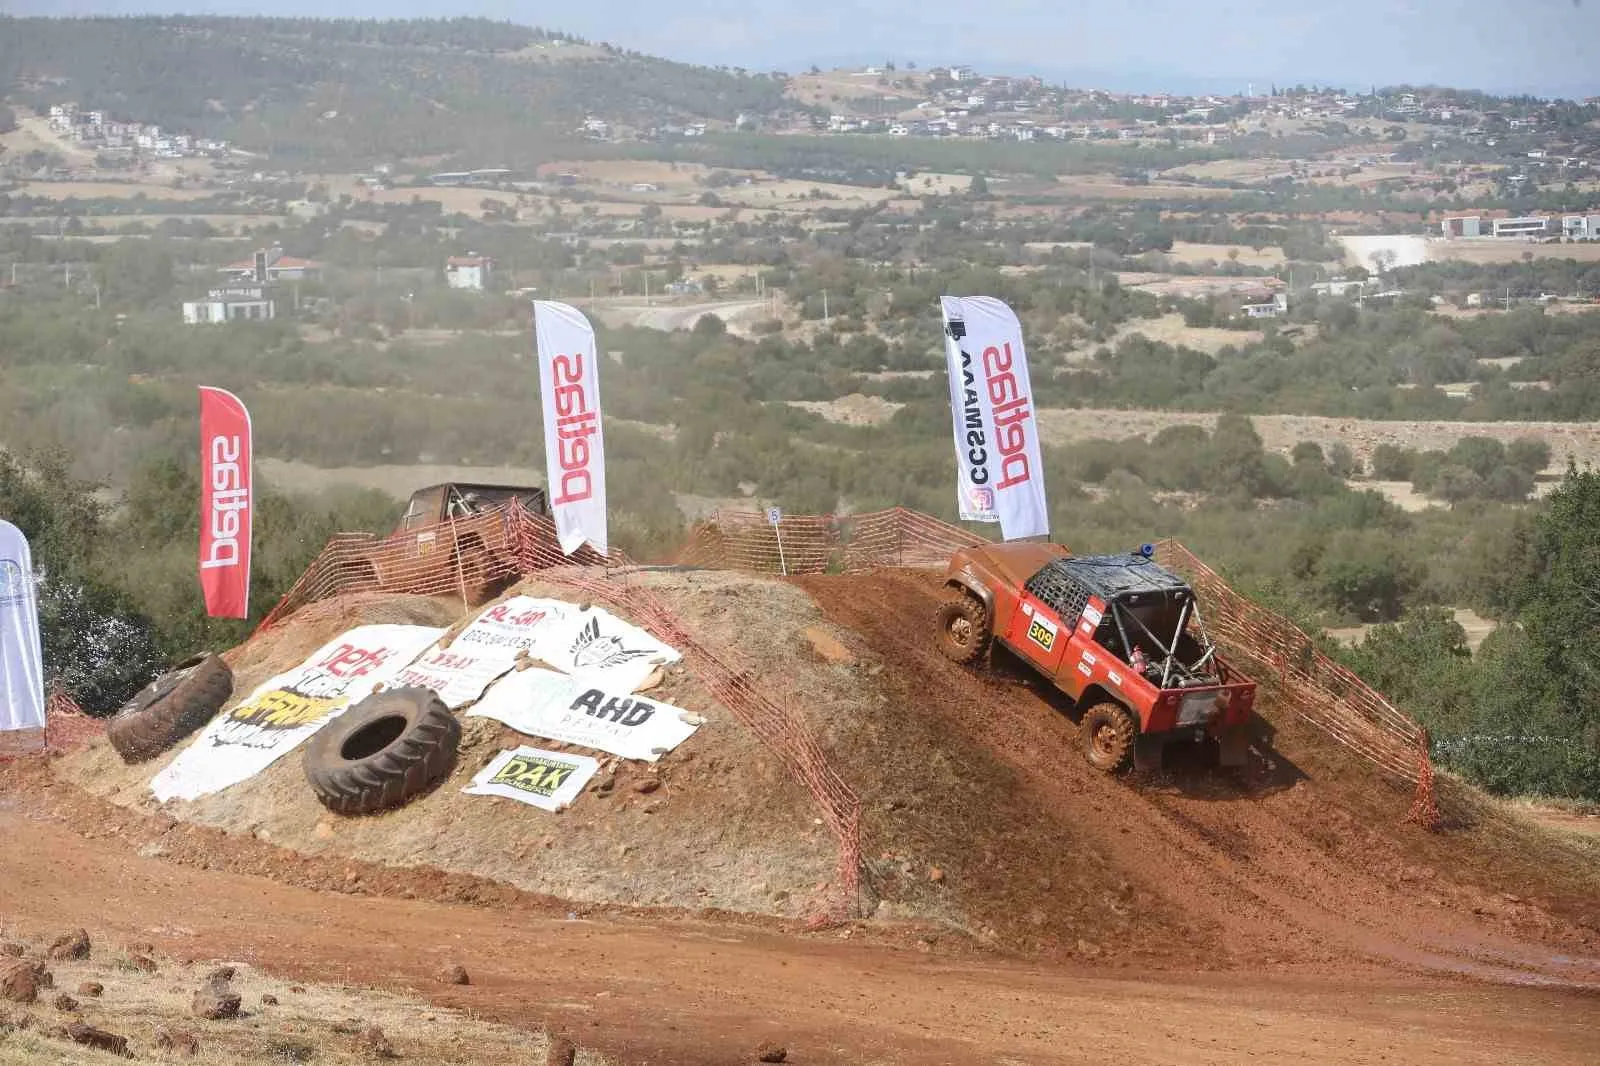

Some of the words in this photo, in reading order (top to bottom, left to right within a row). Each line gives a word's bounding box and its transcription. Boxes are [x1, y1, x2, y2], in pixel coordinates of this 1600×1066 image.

[1030, 623, 1053, 646] 309
[569, 688, 656, 727] AHD
[495, 759, 571, 790] DAK
